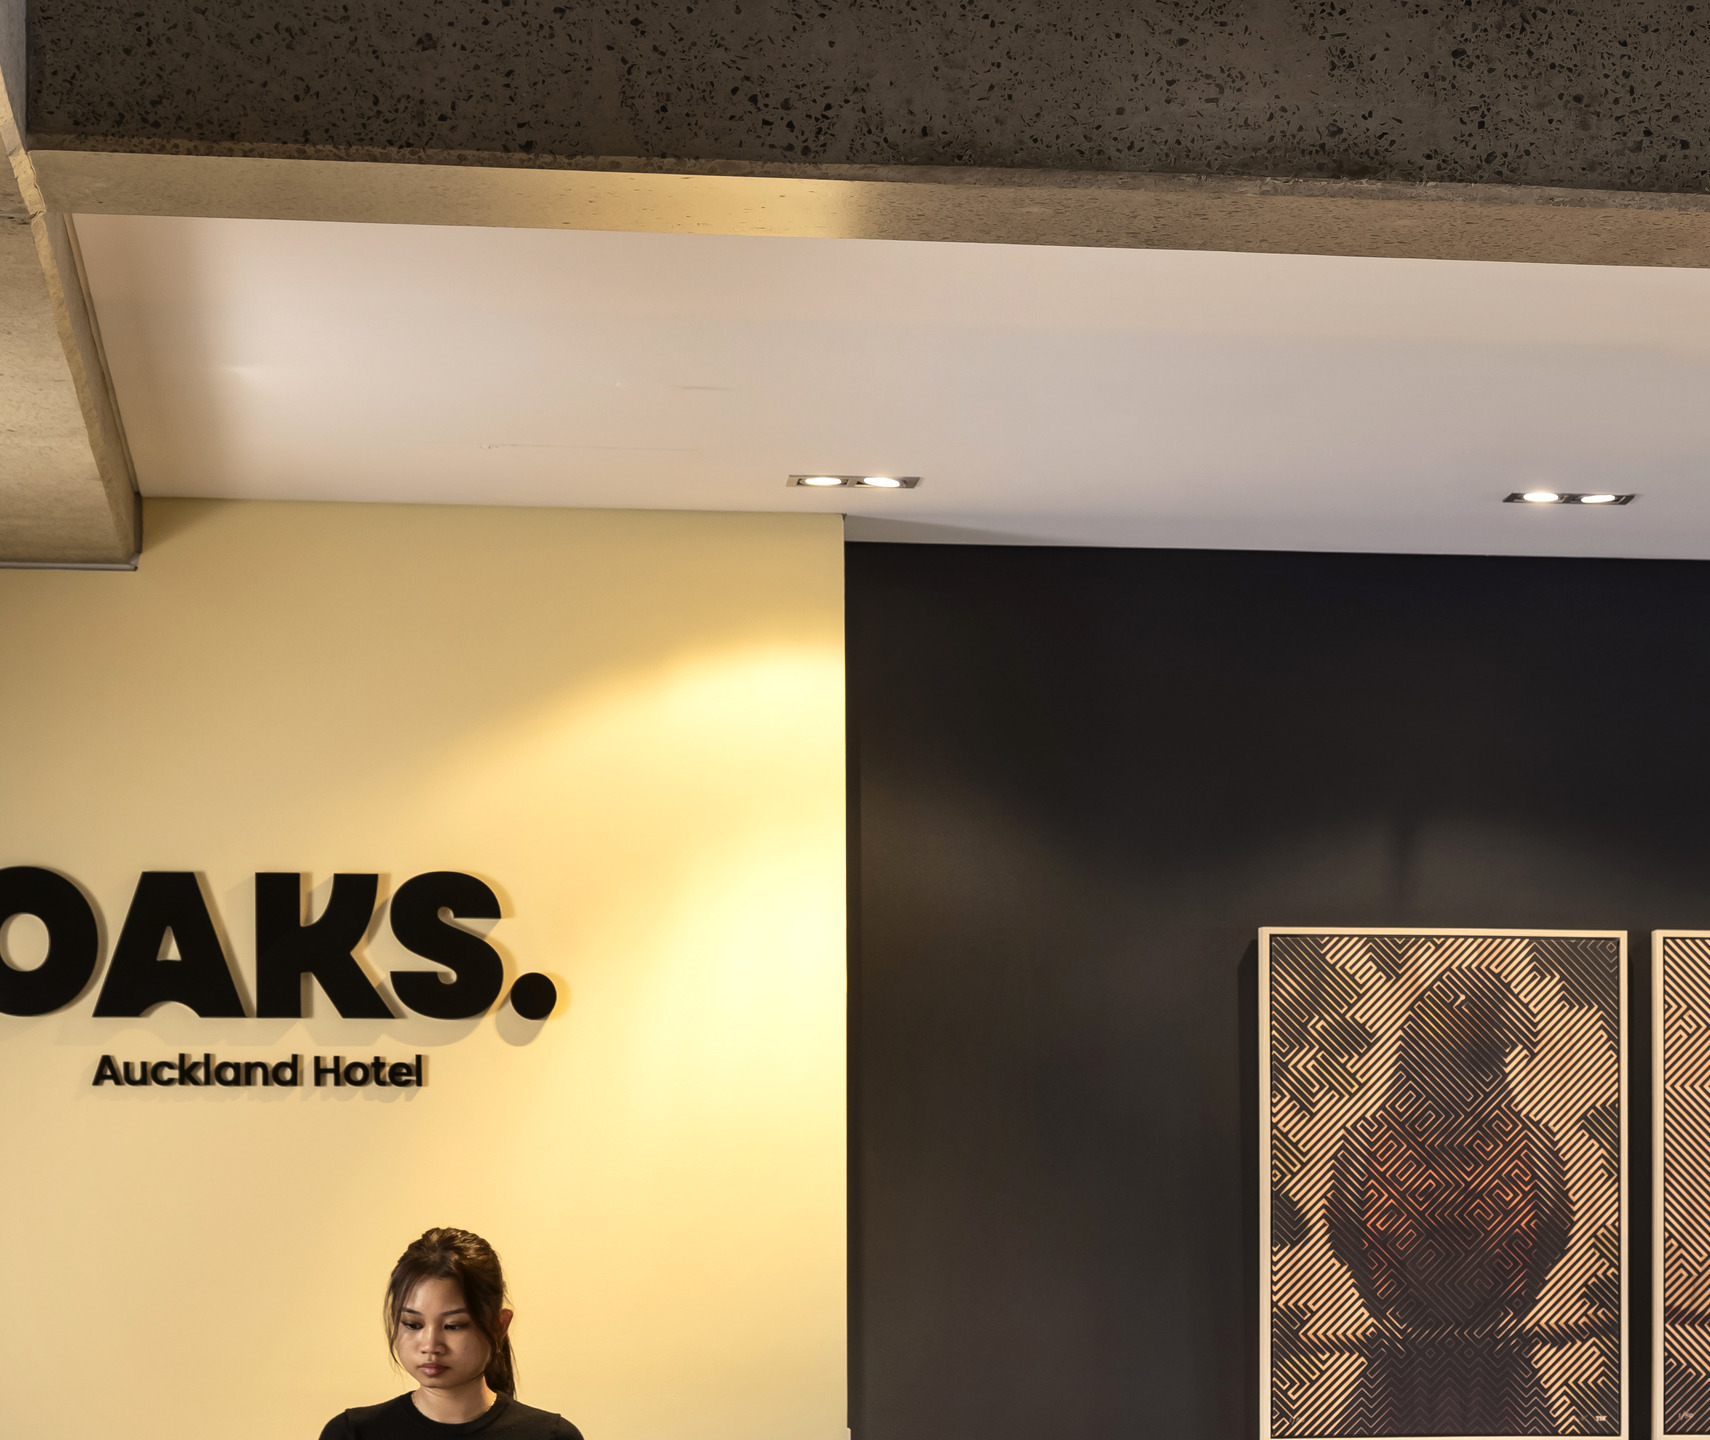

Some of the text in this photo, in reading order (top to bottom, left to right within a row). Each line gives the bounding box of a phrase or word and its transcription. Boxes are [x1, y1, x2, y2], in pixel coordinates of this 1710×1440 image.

[0, 866, 558, 1020] OAKS.
[92, 1052, 424, 1088] Auckland Hotel
